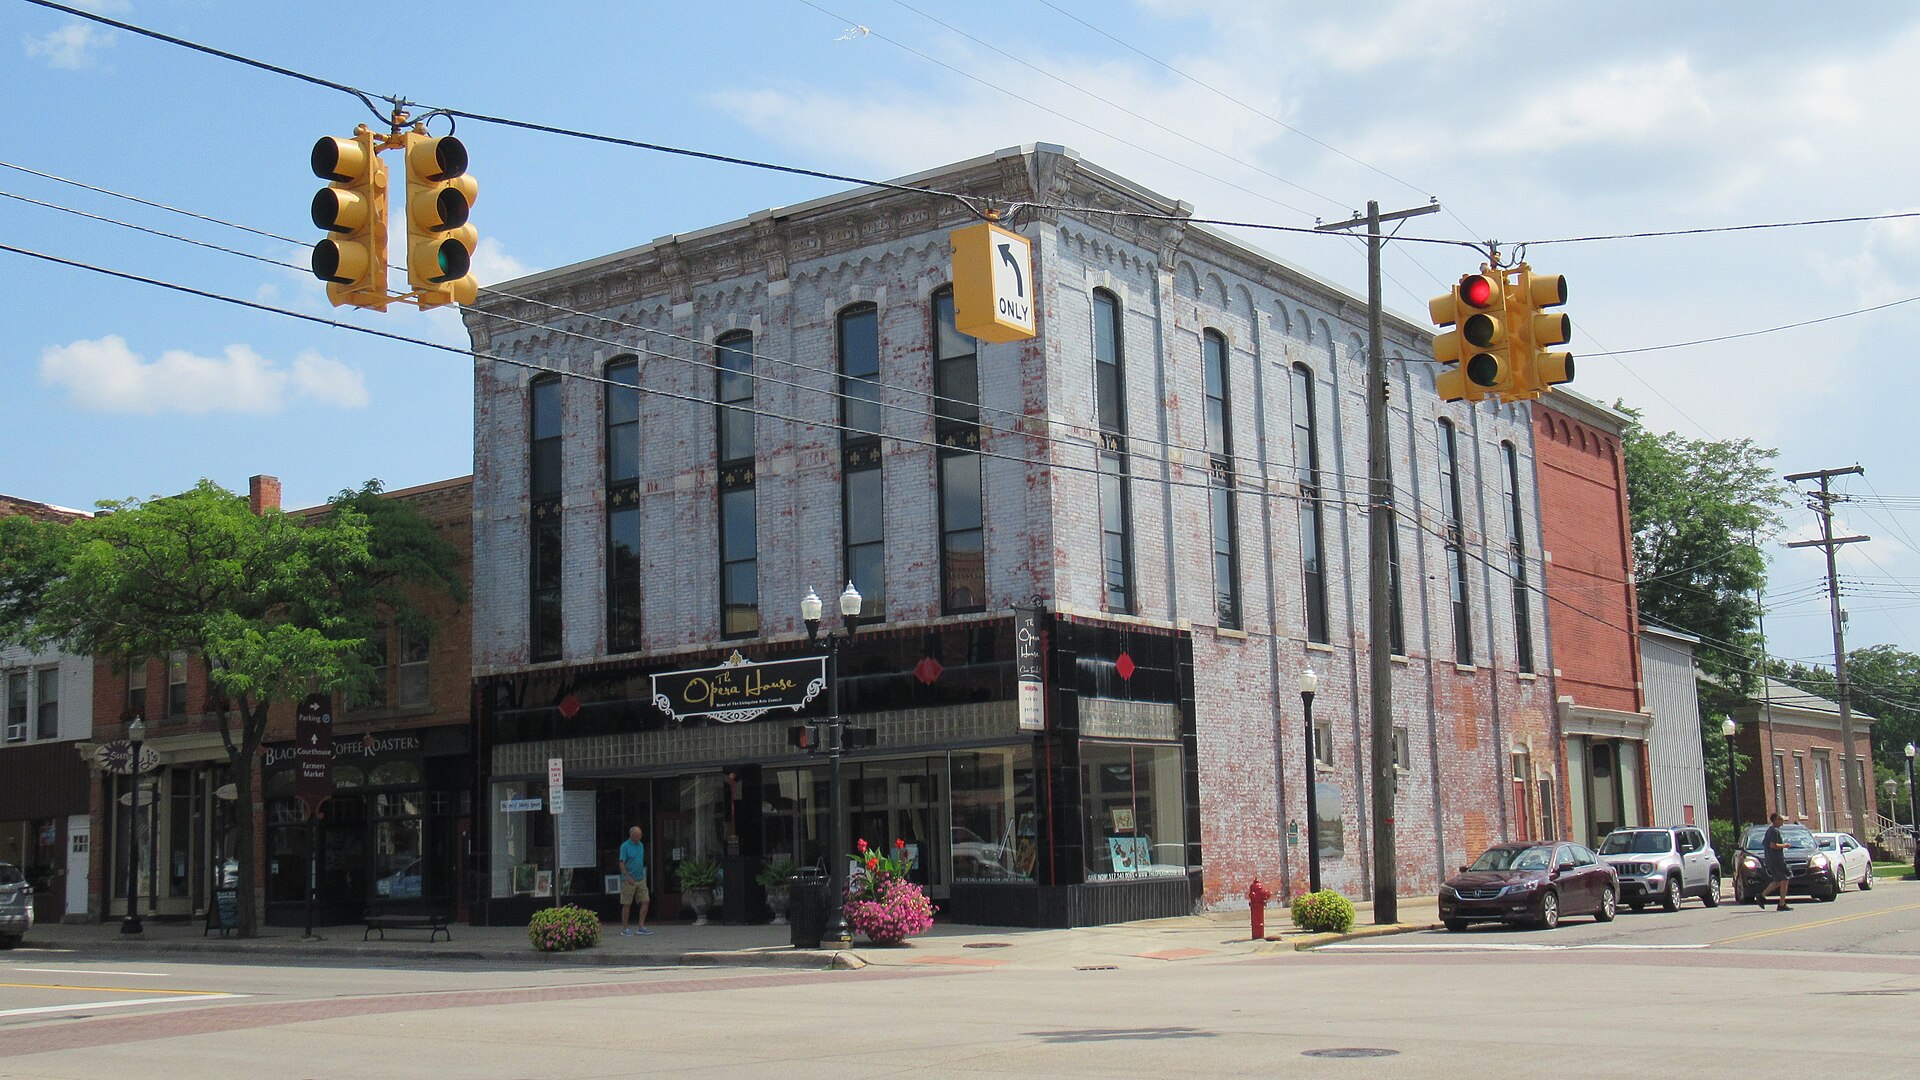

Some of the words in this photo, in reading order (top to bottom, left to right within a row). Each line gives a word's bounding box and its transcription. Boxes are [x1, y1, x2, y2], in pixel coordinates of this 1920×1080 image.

[999, 297, 1029, 321] ONLY
[1018, 628, 1040, 646] Opera
[1020, 644, 1040, 658] House
[715, 671, 732, 685] The
[684, 677, 740, 707] Opera
[746, 669, 797, 696] House
[299, 714, 320, 723] Parking
[297, 747, 331, 756] Courthouse
[303, 770, 325, 778] Market
